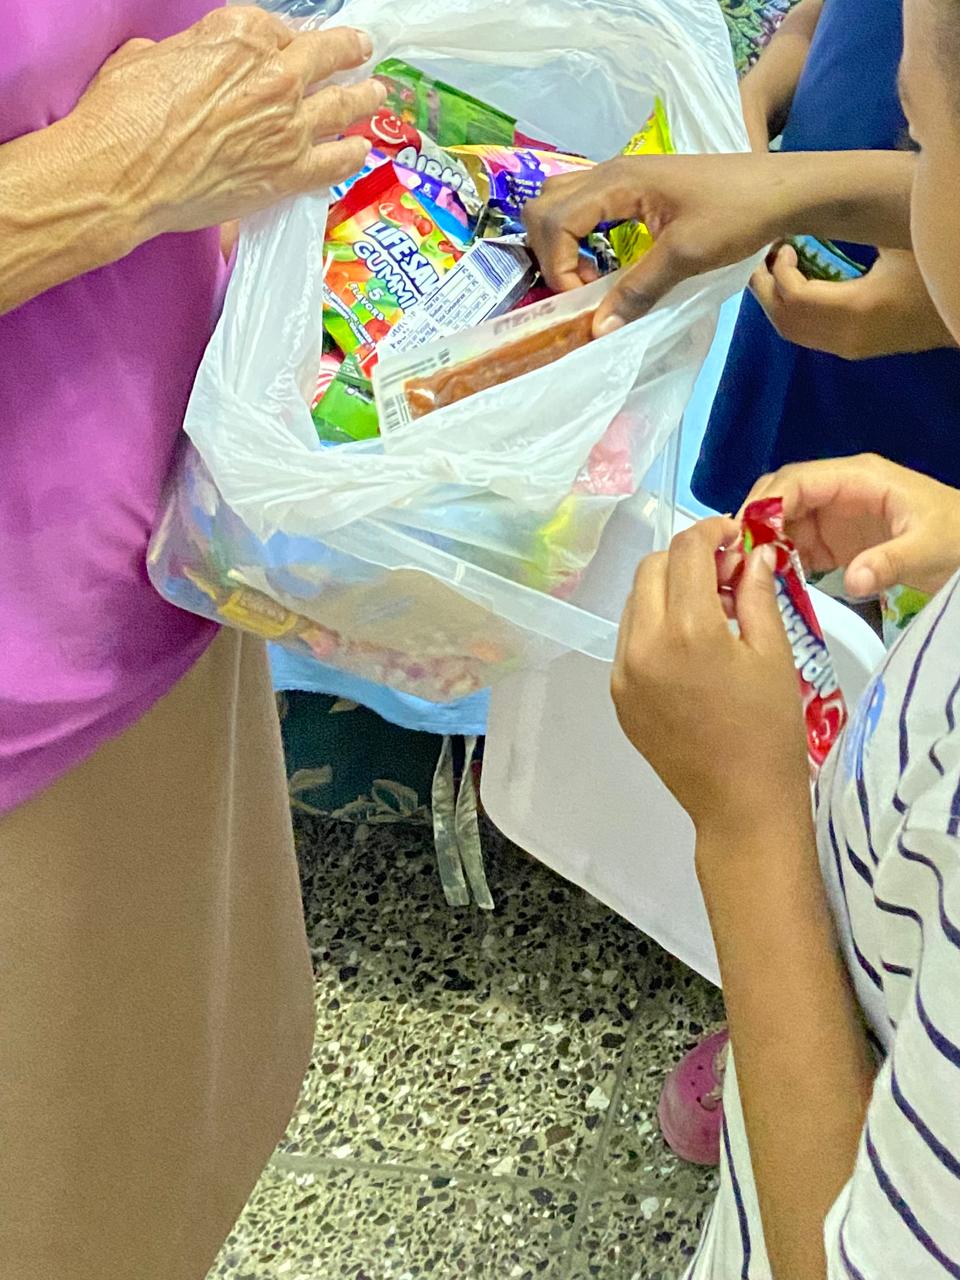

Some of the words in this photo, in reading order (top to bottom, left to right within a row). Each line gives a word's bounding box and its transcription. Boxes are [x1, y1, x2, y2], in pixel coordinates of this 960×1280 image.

[352, 241, 418, 312] GUMMI
[368, 288, 385, 301] 5
[348, 283, 385, 321] FLAVORS
